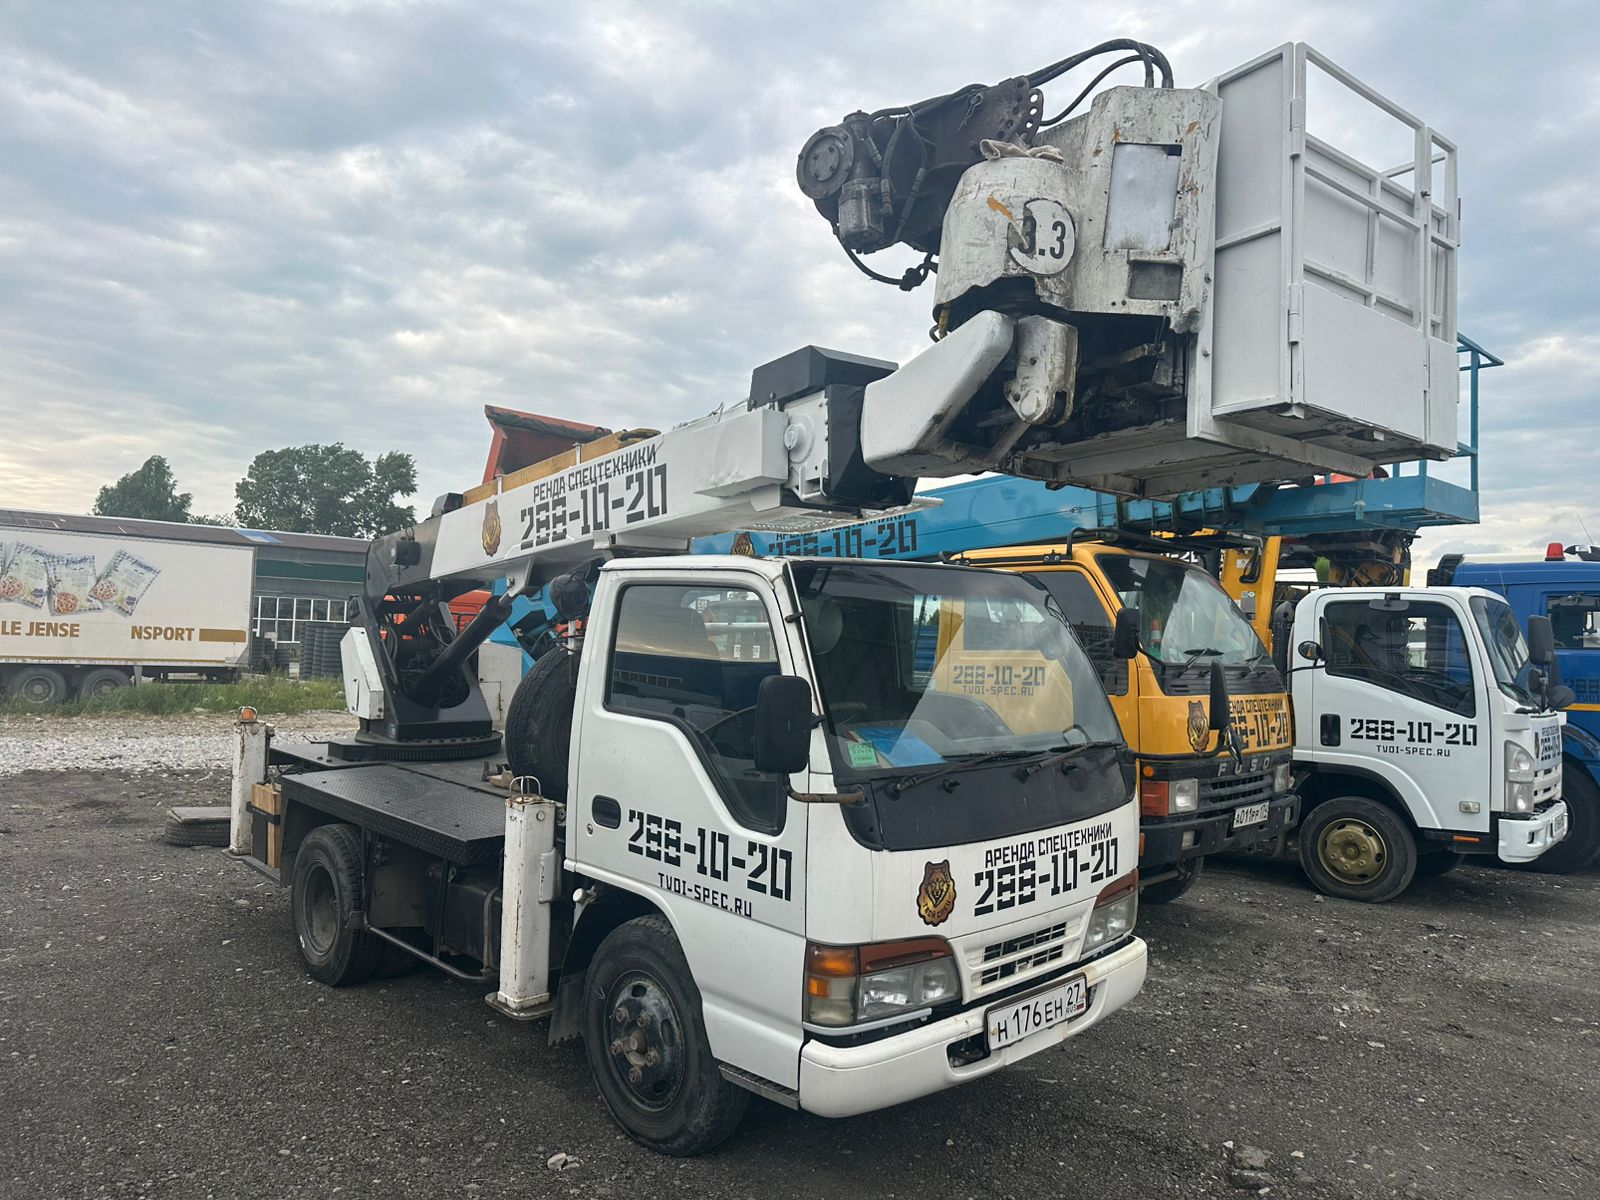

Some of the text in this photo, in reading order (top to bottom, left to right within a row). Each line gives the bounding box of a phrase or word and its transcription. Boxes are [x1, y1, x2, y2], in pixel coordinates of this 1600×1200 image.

[534, 443, 656, 503] РЕНДА СПЕЦТЕХНИКИ
[520, 463, 668, 551] 288-10-20
[25, 621, 80, 638] JENSE
[131, 625, 195, 641] NSPORT
[1351, 718, 1477, 746] 288-10-20
[1376, 744, 1451, 757] TVOI-SPEC.RU
[1217, 757, 1270, 777] FUSO
[628, 809, 792, 901] 288-10-20
[985, 821, 1112, 869] АРЕНДА СПЕЦТЕХНИКИ
[658, 872, 752, 918] TVOI-SPEC.RU
[974, 837, 1118, 917] 288-10-20
[1067, 983, 1080, 1006] 27
